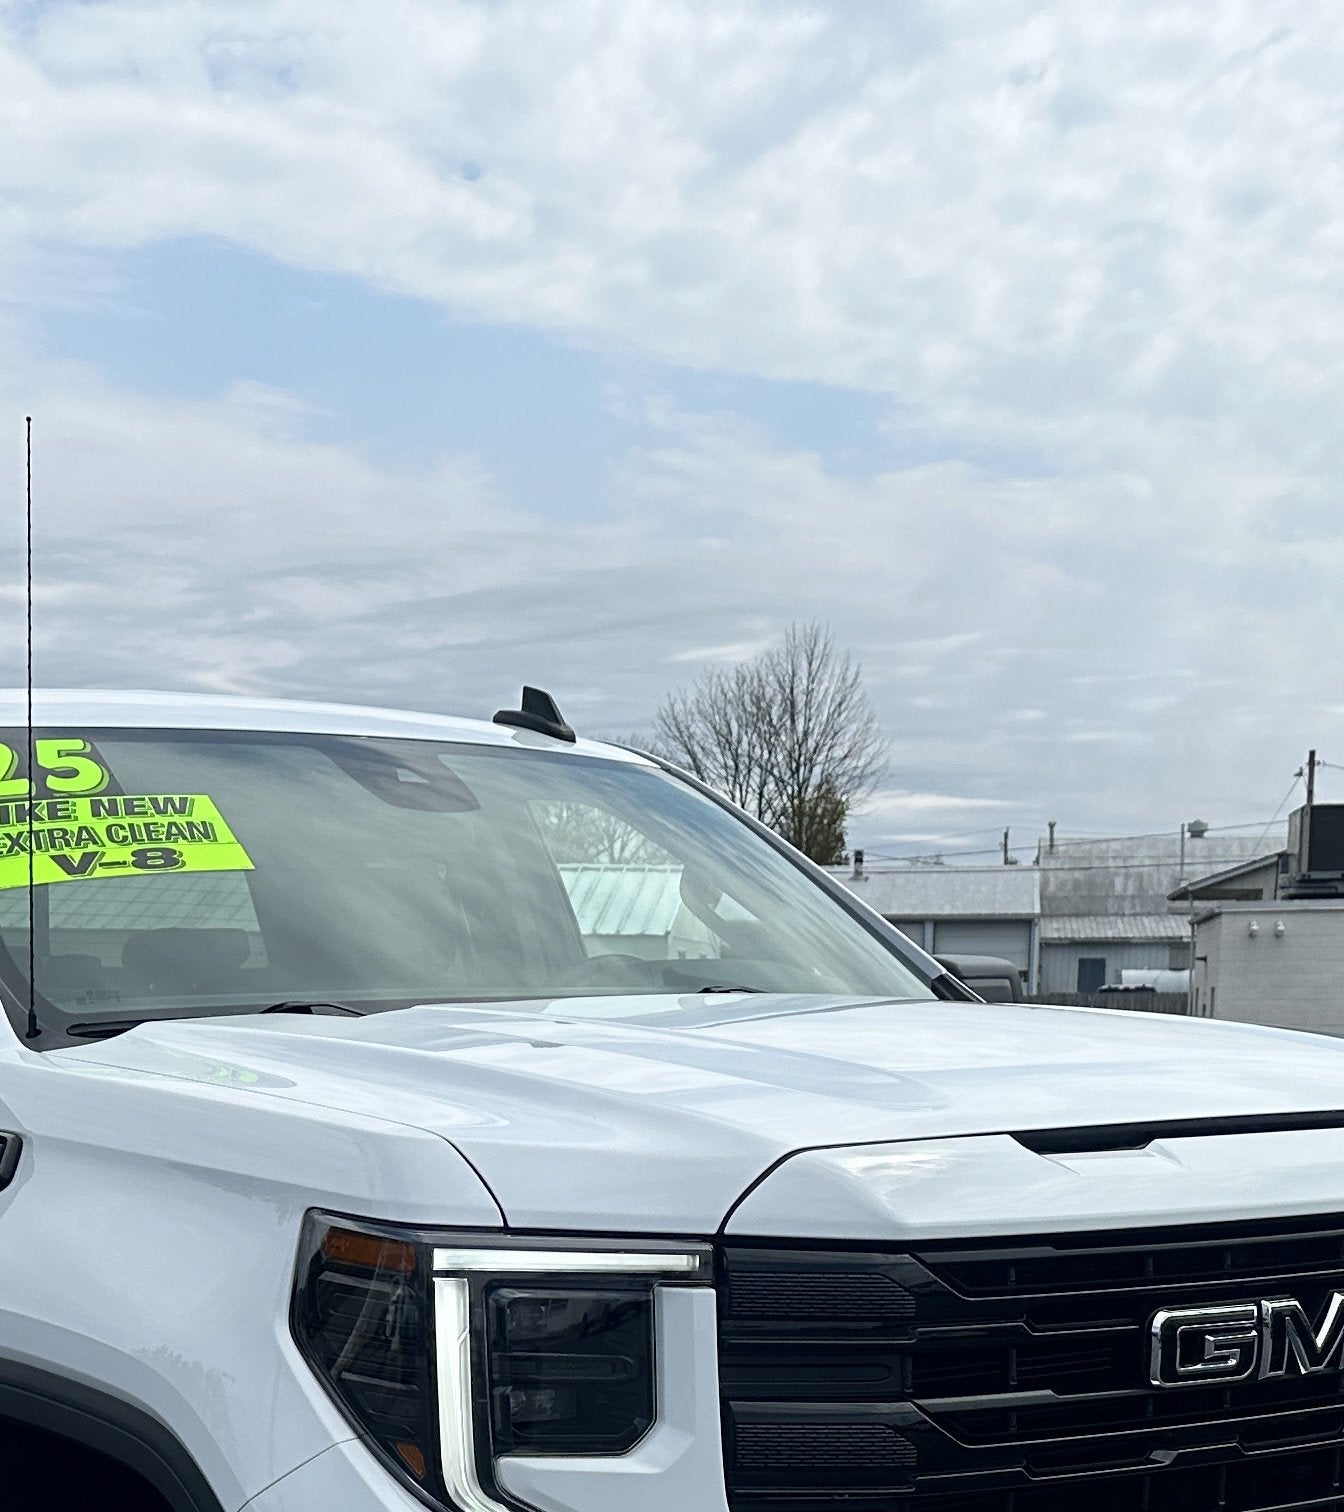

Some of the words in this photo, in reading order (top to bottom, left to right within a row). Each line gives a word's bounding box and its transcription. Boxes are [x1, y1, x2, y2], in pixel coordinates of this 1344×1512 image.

[89, 796, 195, 819] NEW
[105, 820, 219, 846] CLEAN
[47, 847, 187, 877] V-8
